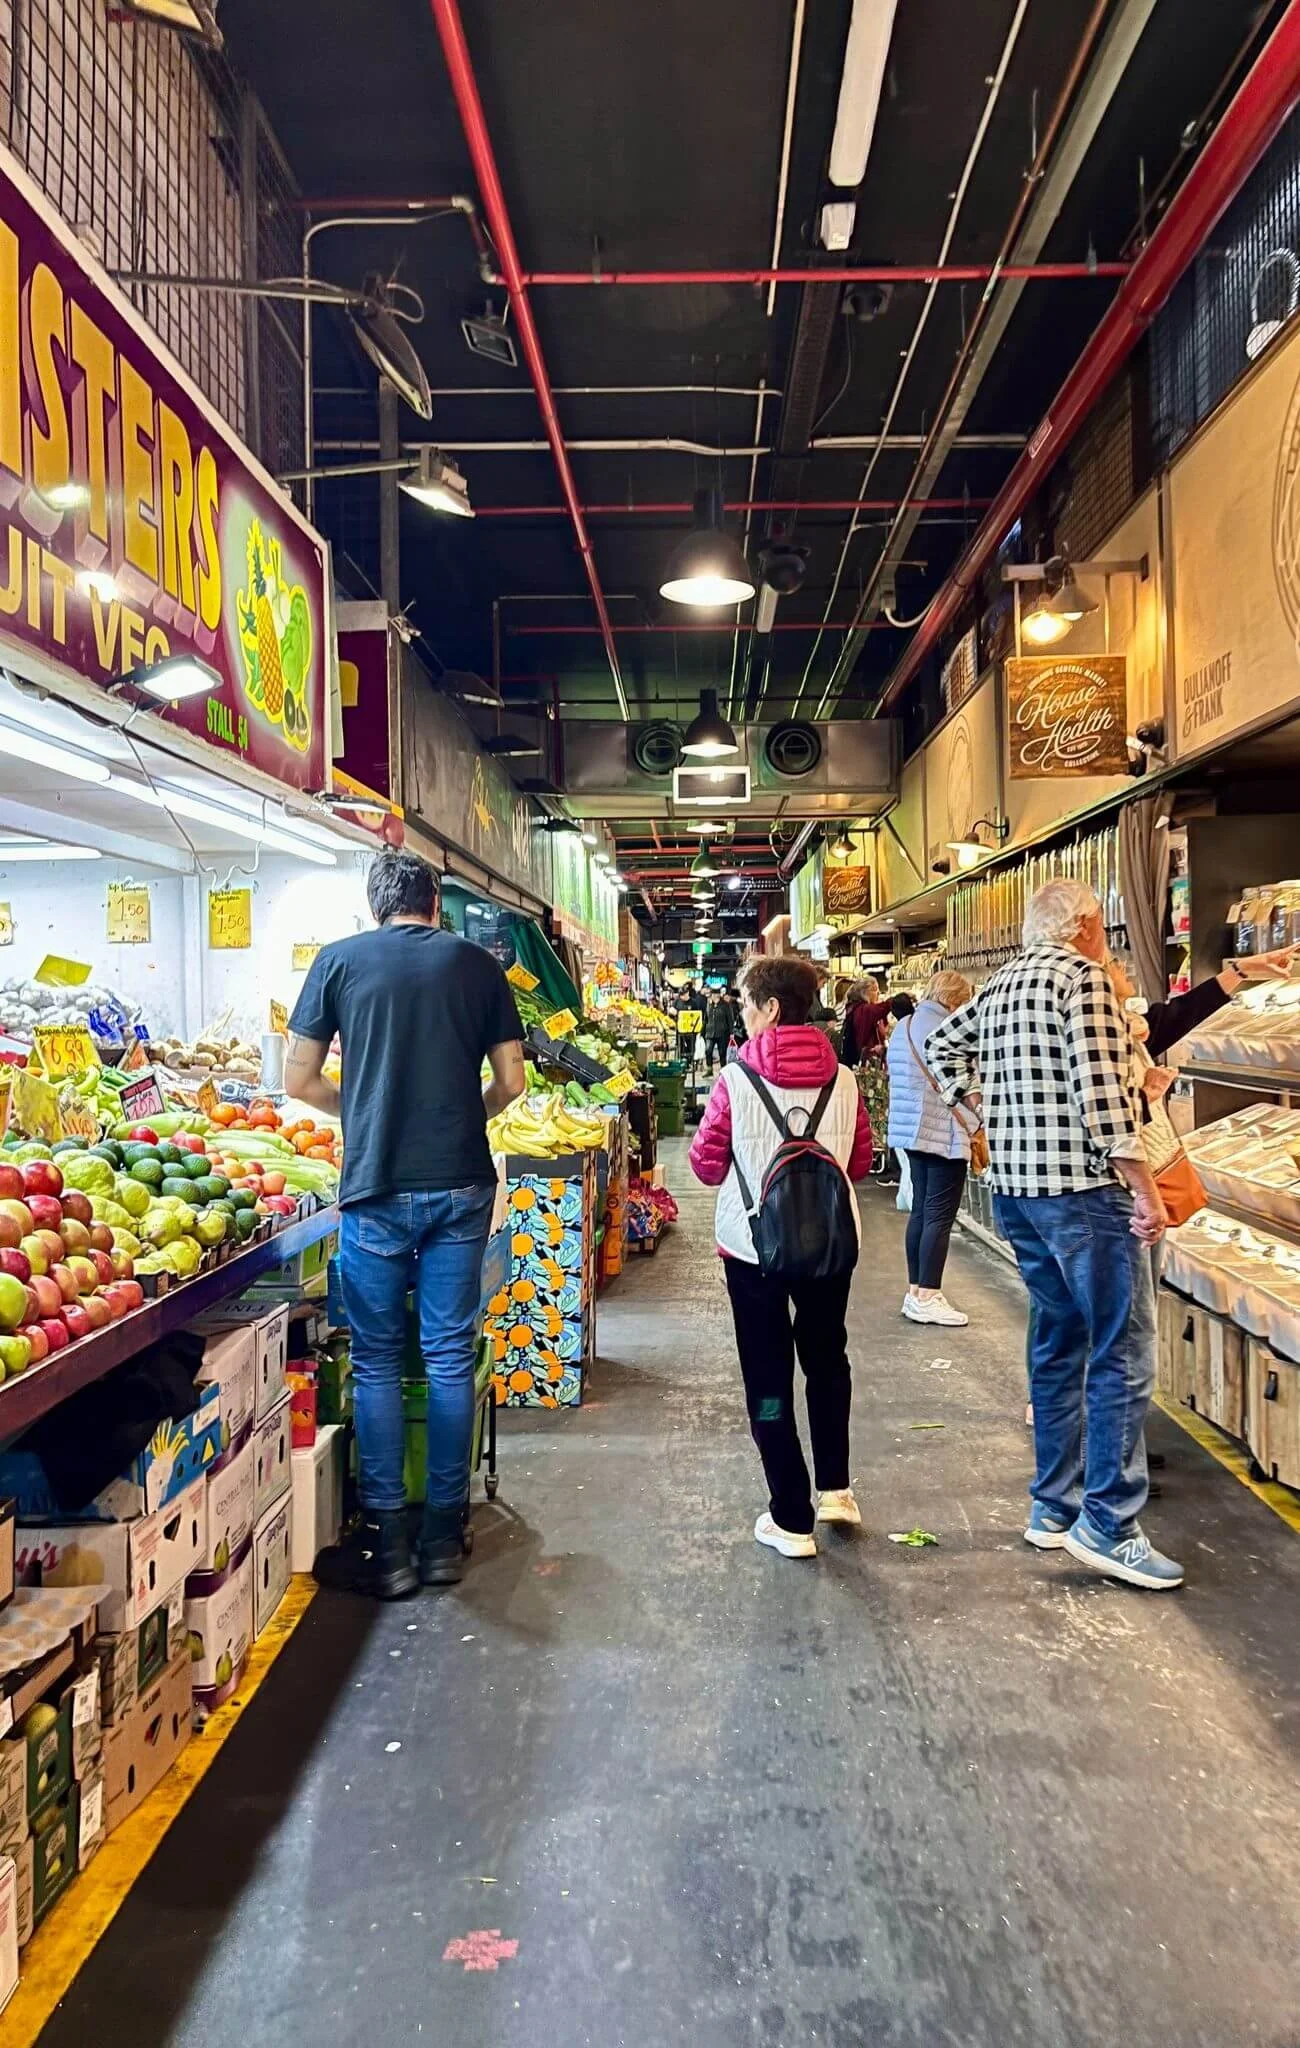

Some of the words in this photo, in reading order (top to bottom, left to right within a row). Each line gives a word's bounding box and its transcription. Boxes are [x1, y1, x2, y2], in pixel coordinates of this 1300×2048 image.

[207, 697, 235, 744] STALL
[1016, 683, 1097, 731] House
[1075, 702, 1091, 721] of
[1194, 687, 1223, 728] FRANK
[1020, 707, 1115, 772] Health
